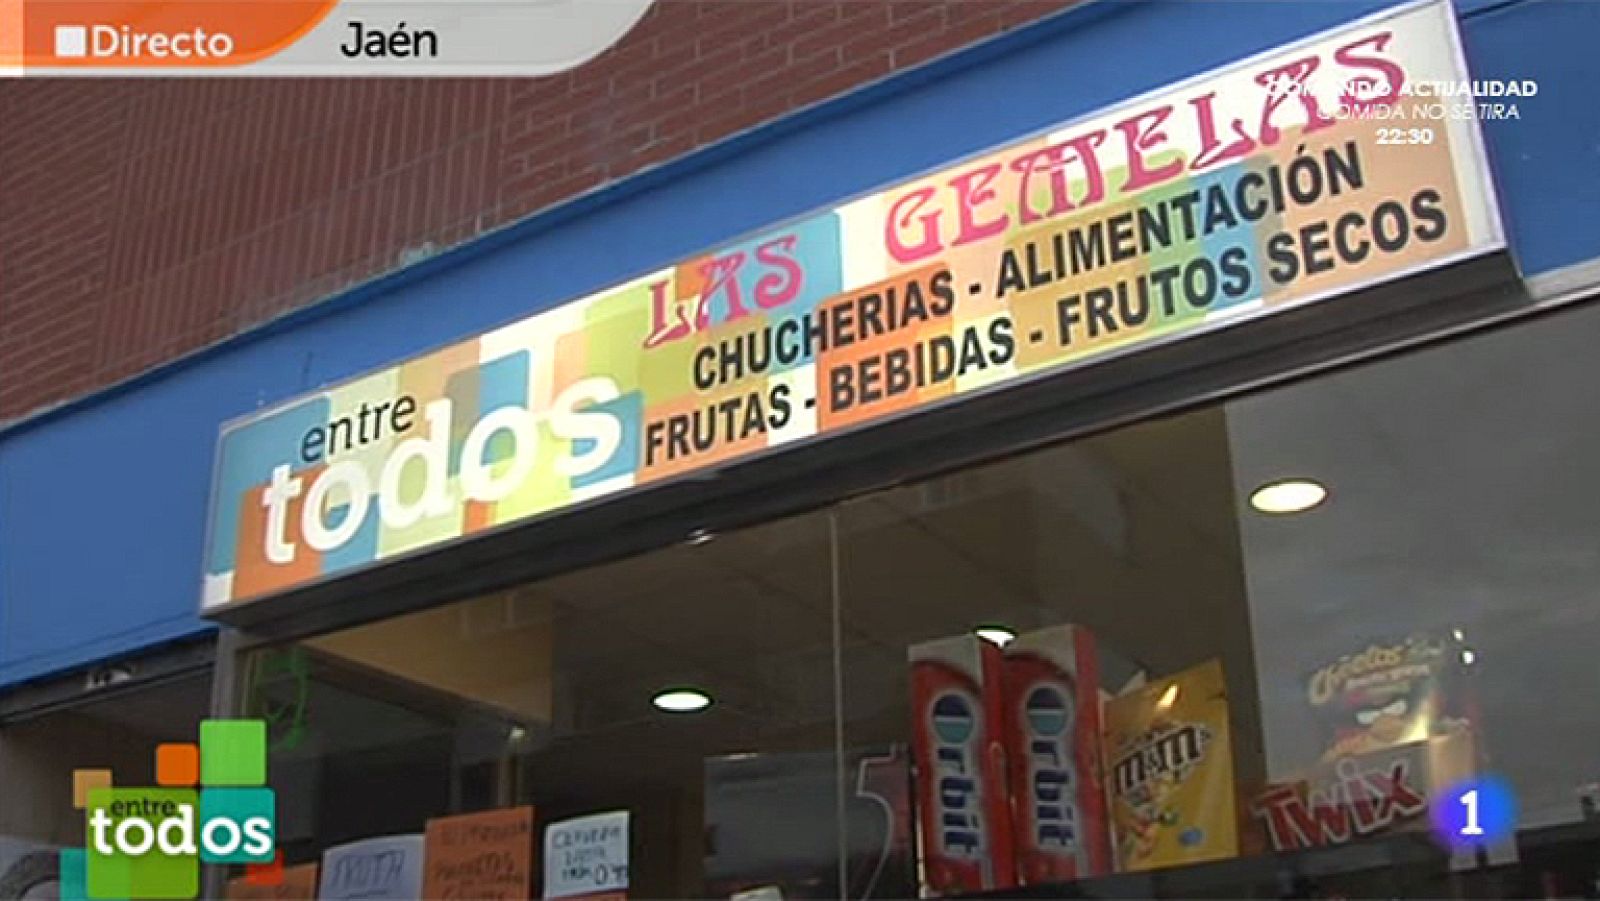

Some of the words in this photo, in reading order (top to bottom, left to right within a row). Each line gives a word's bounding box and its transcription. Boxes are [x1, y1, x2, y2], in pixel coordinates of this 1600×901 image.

[643, 234, 804, 348] LAS
[884, 30, 1405, 264] GEMELAS
[693, 269, 956, 390] CHUCHERIAS
[996, 141, 1363, 299] ALIMENTACIÓN
[301, 394, 416, 463] entre
[645, 383, 791, 468] FRUTAS
[829, 317, 1016, 414] BEBIDAS
[1057, 247, 1252, 347] FRUTOS
[1266, 189, 1448, 286] SECOS
[262, 375, 622, 565] todos
